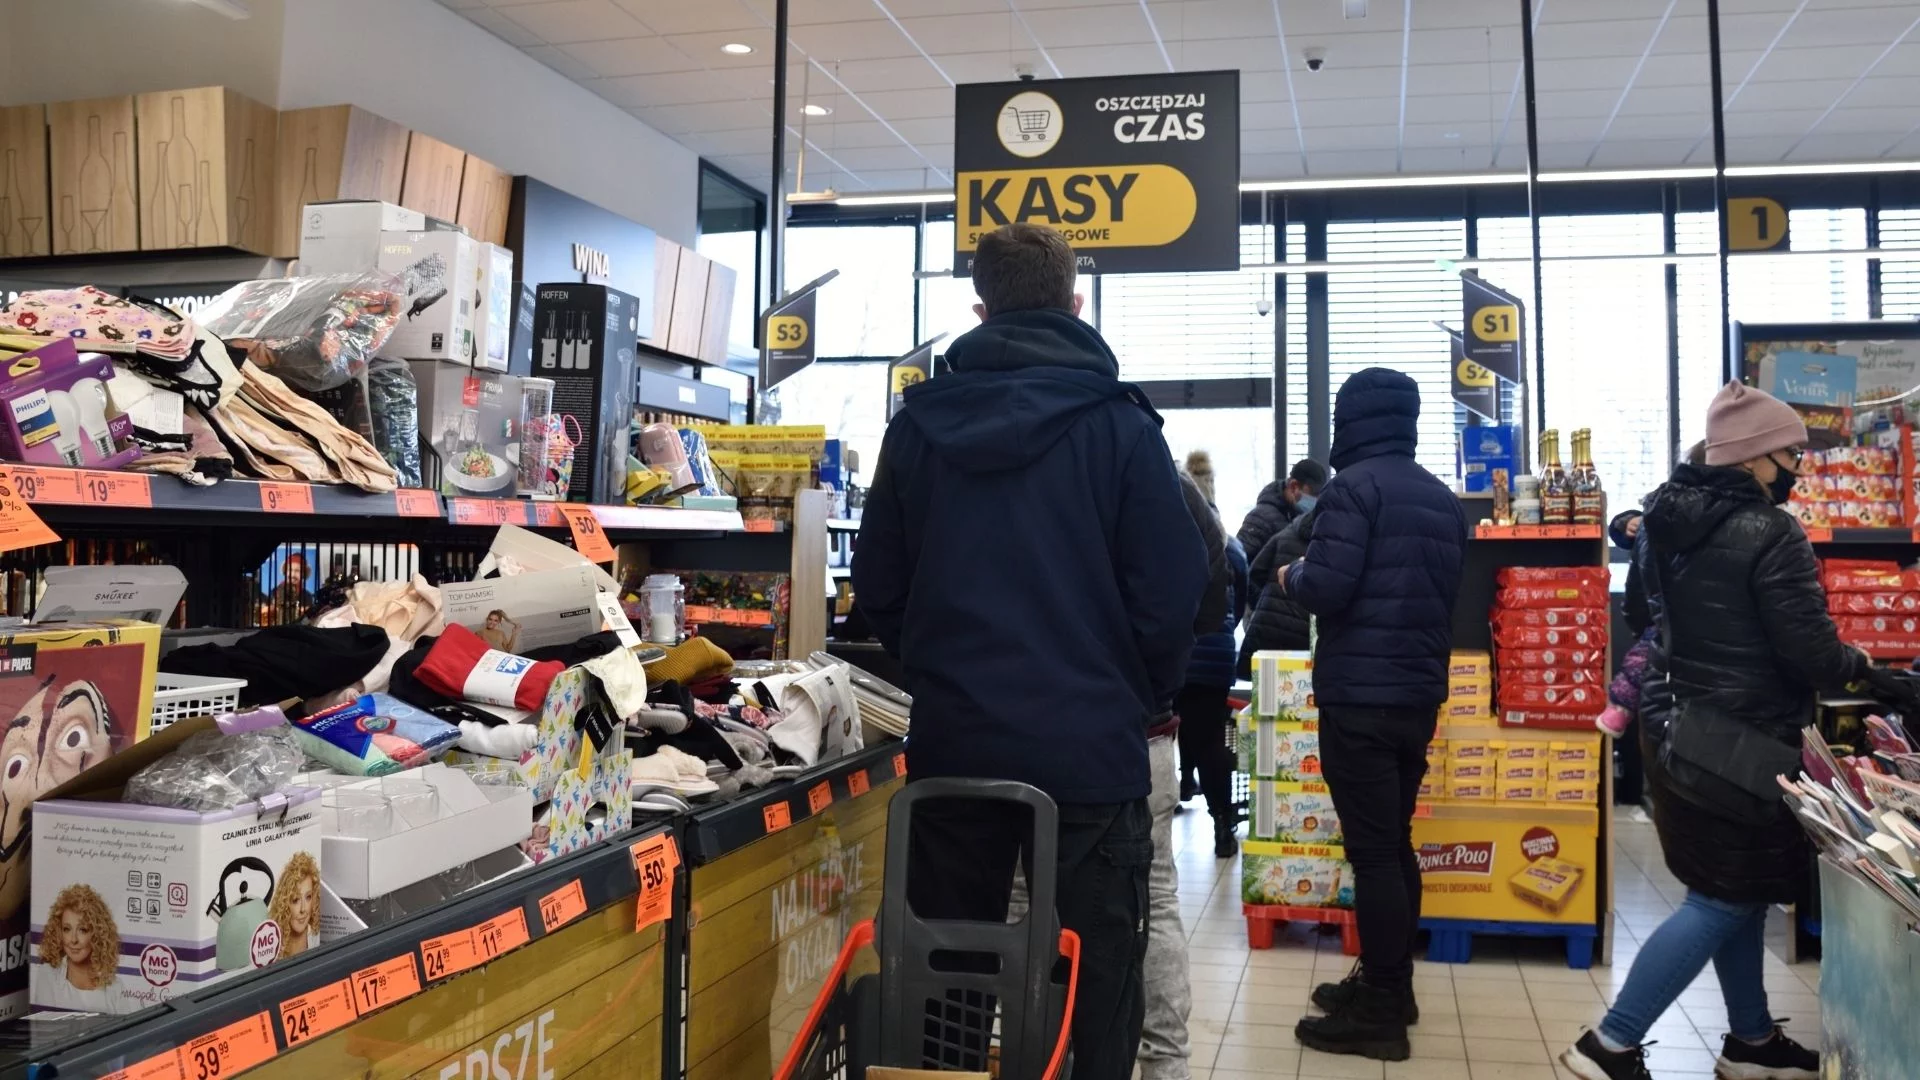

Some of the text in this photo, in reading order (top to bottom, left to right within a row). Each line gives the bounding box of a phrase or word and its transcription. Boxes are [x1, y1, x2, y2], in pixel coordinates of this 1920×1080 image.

[1095, 94, 1205, 112] OSZCZĘDZAJ
[1114, 112, 1205, 143] CZAS
[969, 173, 1139, 226] KASY
[1751, 206, 1767, 240] 1
[572, 243, 609, 277] WINA
[541, 291, 568, 300] HOFFEN
[776, 324, 802, 341] S3
[1484, 314, 1510, 333] S1
[901, 372, 919, 386] S4
[1467, 364, 1489, 379] S2
[15, 397, 46, 414] PHILIPS
[15, 476, 36, 499] 29
[88, 479, 109, 501] 19
[268, 490, 276, 509] 9
[496, 506, 507, 522] 79
[448, 588, 494, 601] TOP DAMSKI
[11, 657, 32, 672] PAPEL
[1302, 783, 1326, 793] MEGA
[222, 828, 248, 841] CZAJNIK
[249, 826, 257, 835] ZE
[258, 822, 274, 833] STALI
[246, 827, 301, 848] LINIA GALAXY PURE
[1281, 846, 1330, 856] MEGA PAKA
[772, 842, 864, 942] NAJLEPSZE
[545, 904, 558, 929] 44
[258, 933, 273, 949] MG
[483, 931, 497, 956] 11
[148, 956, 168, 967] MG
[257, 947, 273, 958] home
[148, 967, 168, 976] home
[426, 948, 450, 977] 24 99
[361, 975, 387, 1007] 17 99
[287, 1006, 317, 1043] 24 99
[194, 1040, 229, 1080] 39 99
